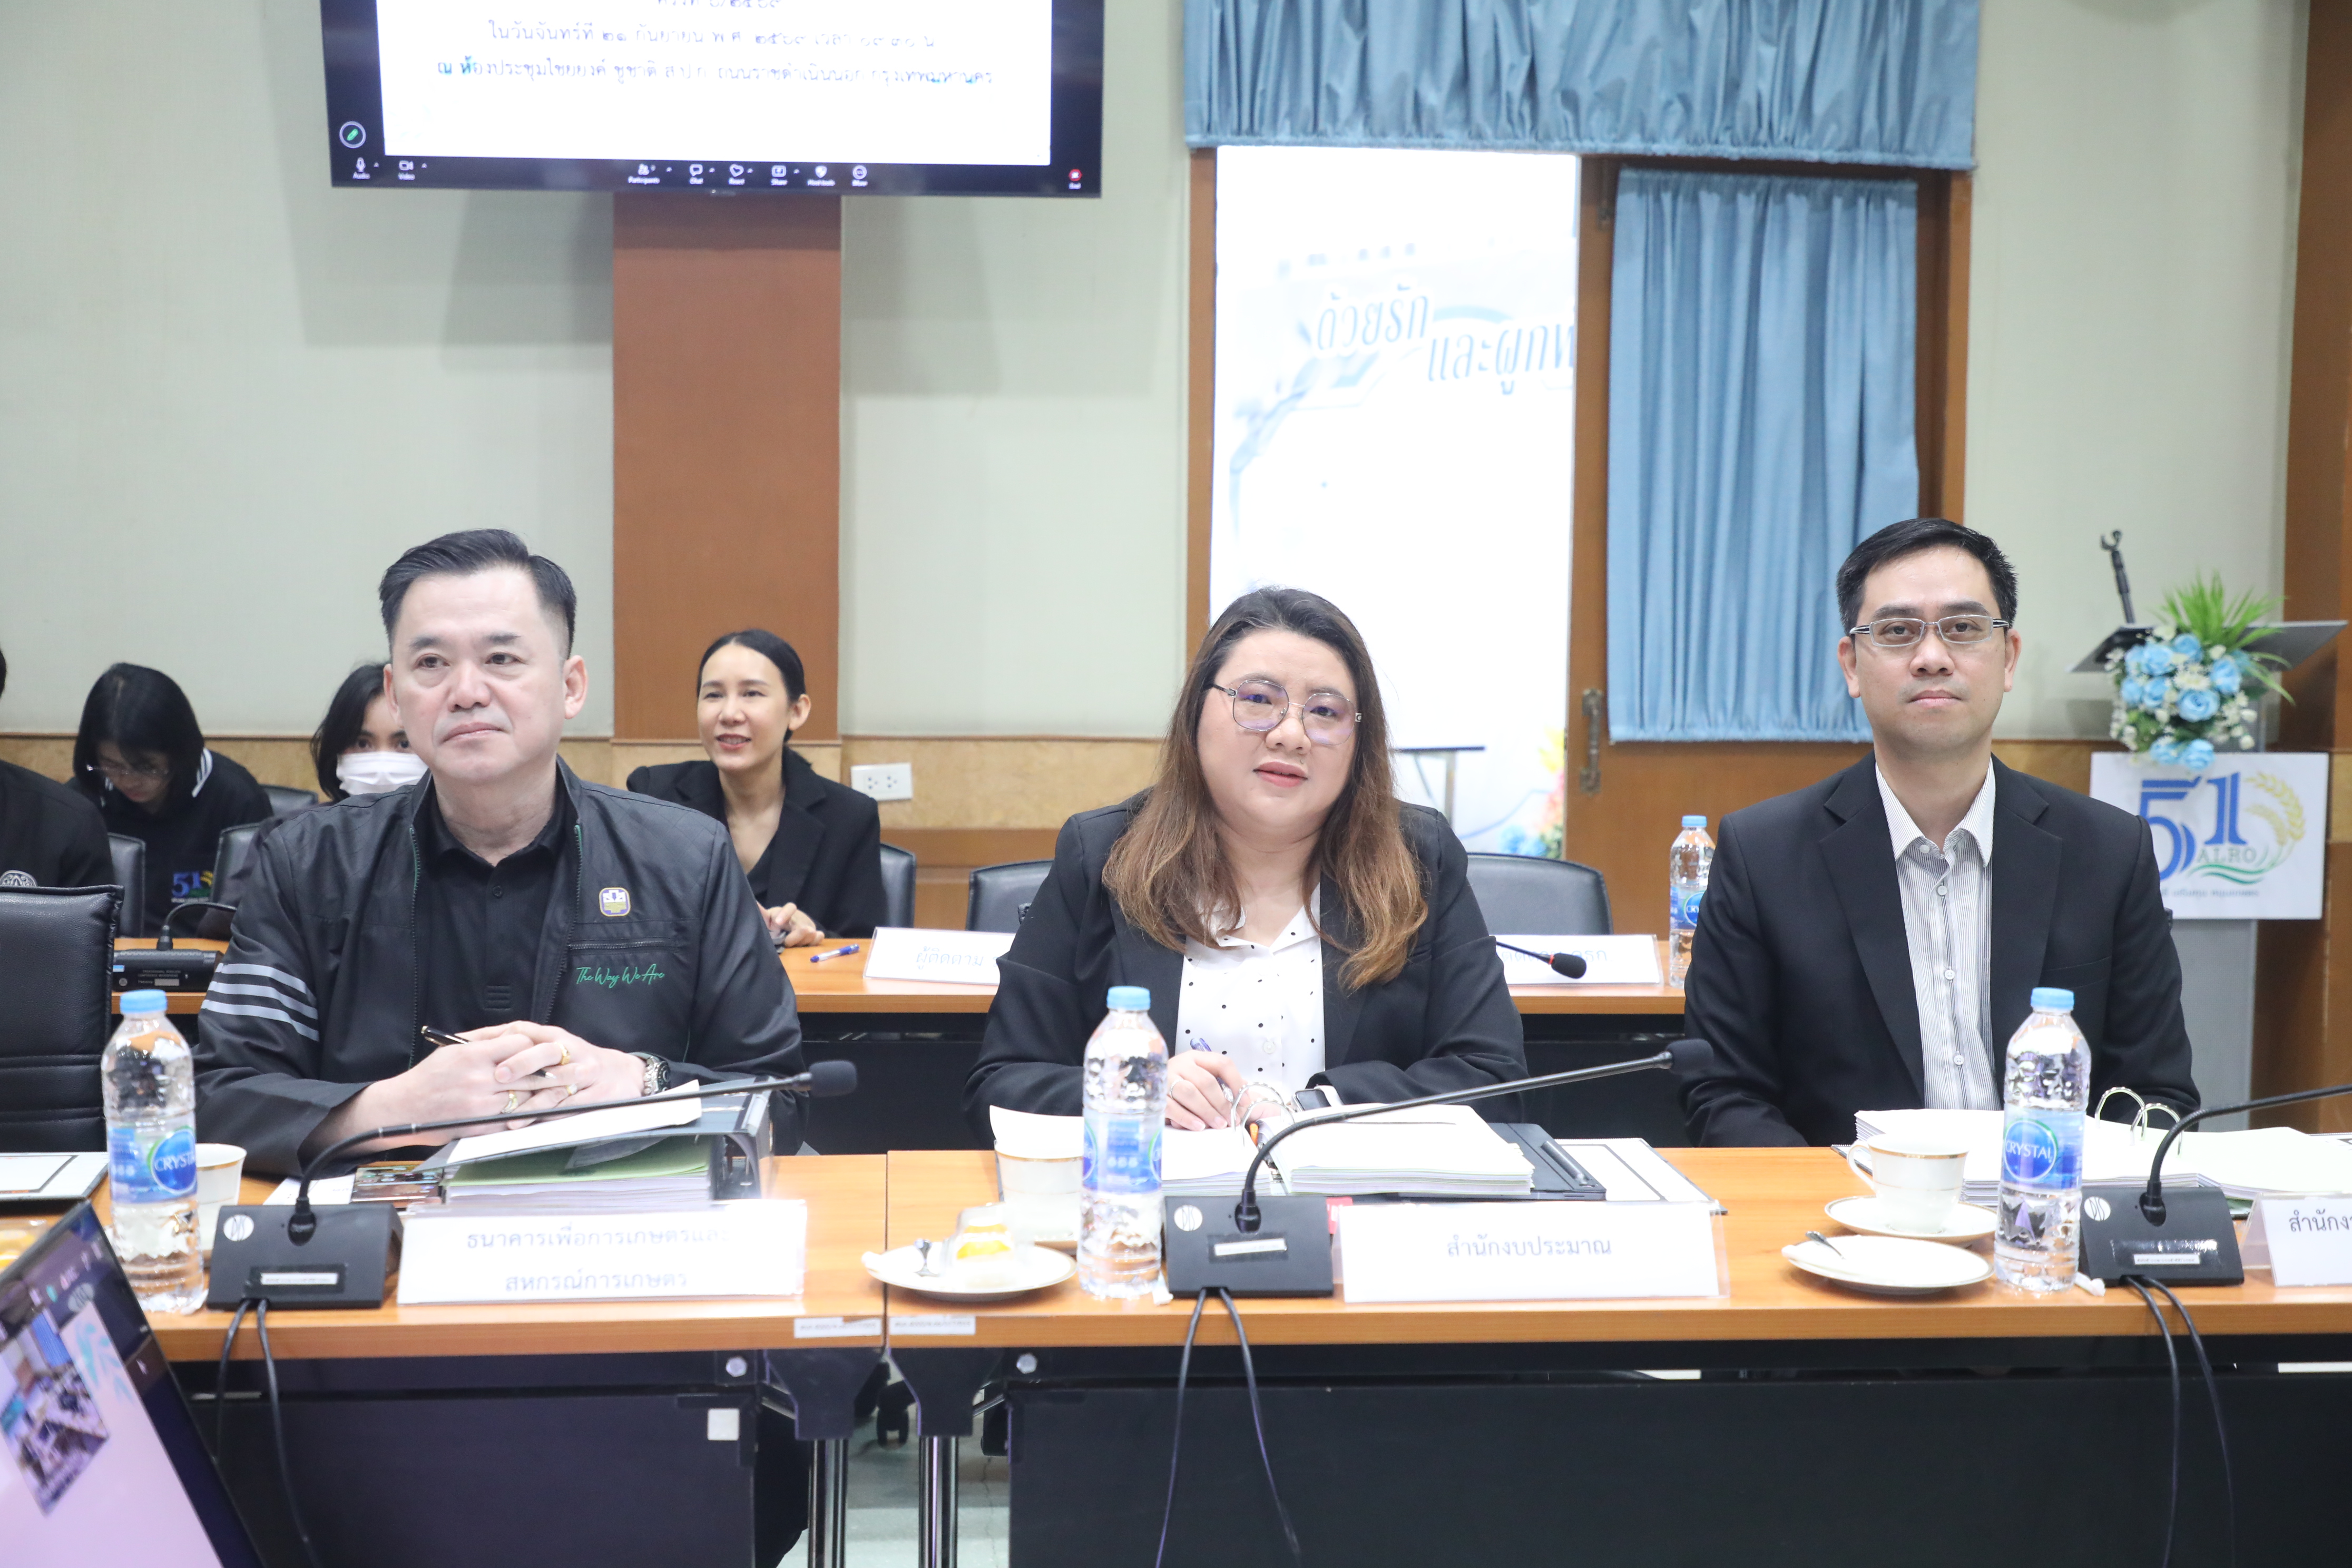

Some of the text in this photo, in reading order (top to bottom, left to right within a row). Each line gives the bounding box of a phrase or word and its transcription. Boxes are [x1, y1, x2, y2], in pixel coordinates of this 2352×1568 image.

[488, 19, 594, 41] ในวันจันทร์ที
[636, 23, 703, 44] กันยายน
[712, 31, 742, 44] พศ
[860, 38, 916, 48] ๐๙๓๐
[923, 36, 935, 48] น
[437, 62, 453, 76] ณ
[614, 61, 658, 85] ชูชาติ
[664, 64, 707, 80] สปก
[1317, 282, 1429, 352] ด้วยรัก
[1427, 324, 1575, 397] และผูกพ
[2139, 772, 2247, 881] 51
[916, 945, 984, 970] ผู้ติดตาม
[576, 963, 665, 988] The Way We Are
[154, 1153, 195, 1172] CRYST
[1447, 1233, 1613, 1258] สำนักงบประมาณ
[505, 1269, 688, 1292] สหกรณ์การเกษตร
